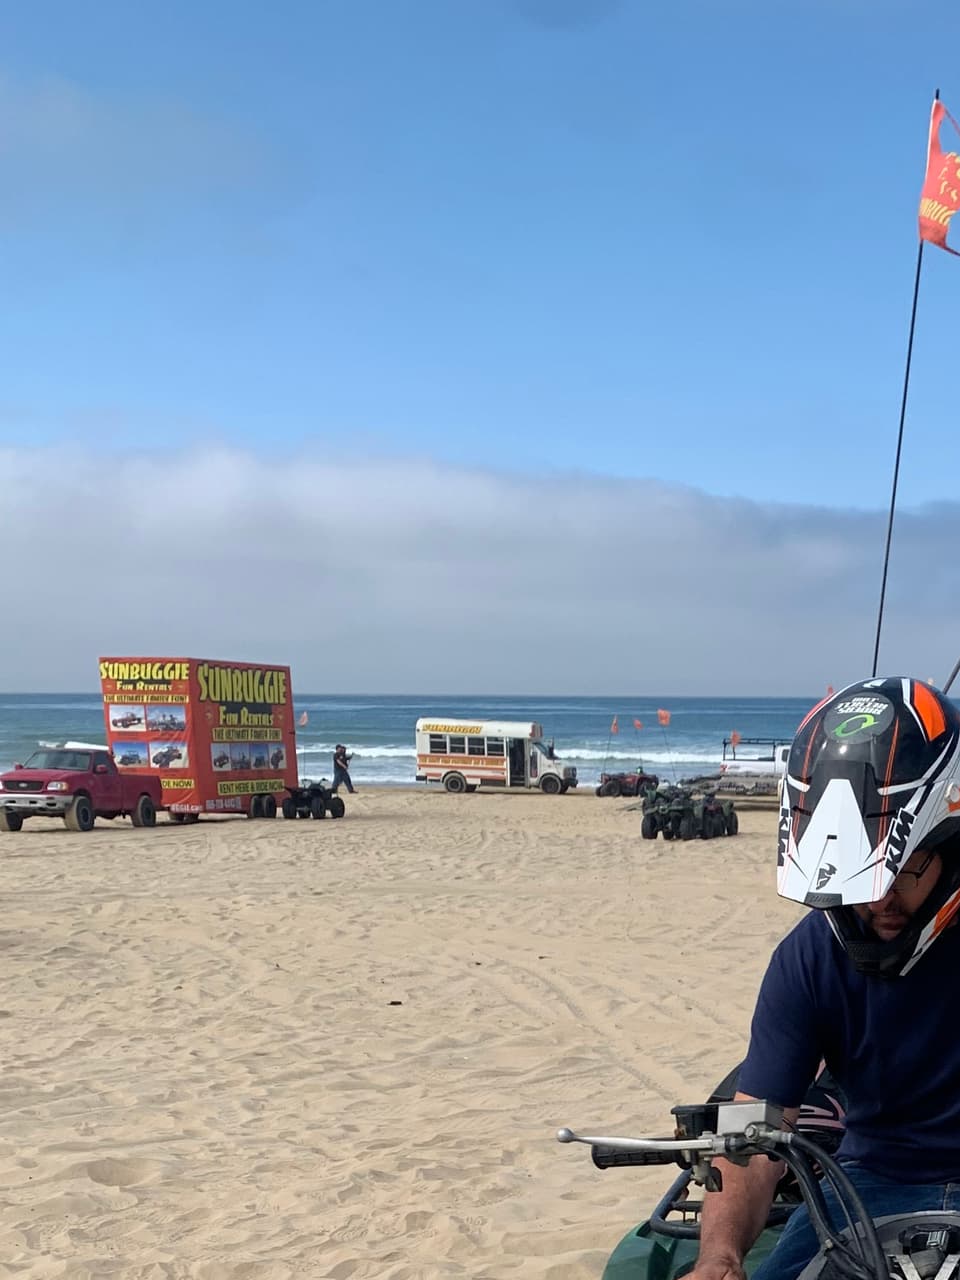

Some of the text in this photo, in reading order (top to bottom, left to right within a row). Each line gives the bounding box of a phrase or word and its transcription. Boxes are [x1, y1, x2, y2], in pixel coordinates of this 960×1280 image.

[99, 662, 190, 680] SUNBUGGIE
[197, 663, 286, 704] SUNBUGGIE
[172, 780, 192, 788] NOW
[885, 809, 917, 877] KTM
